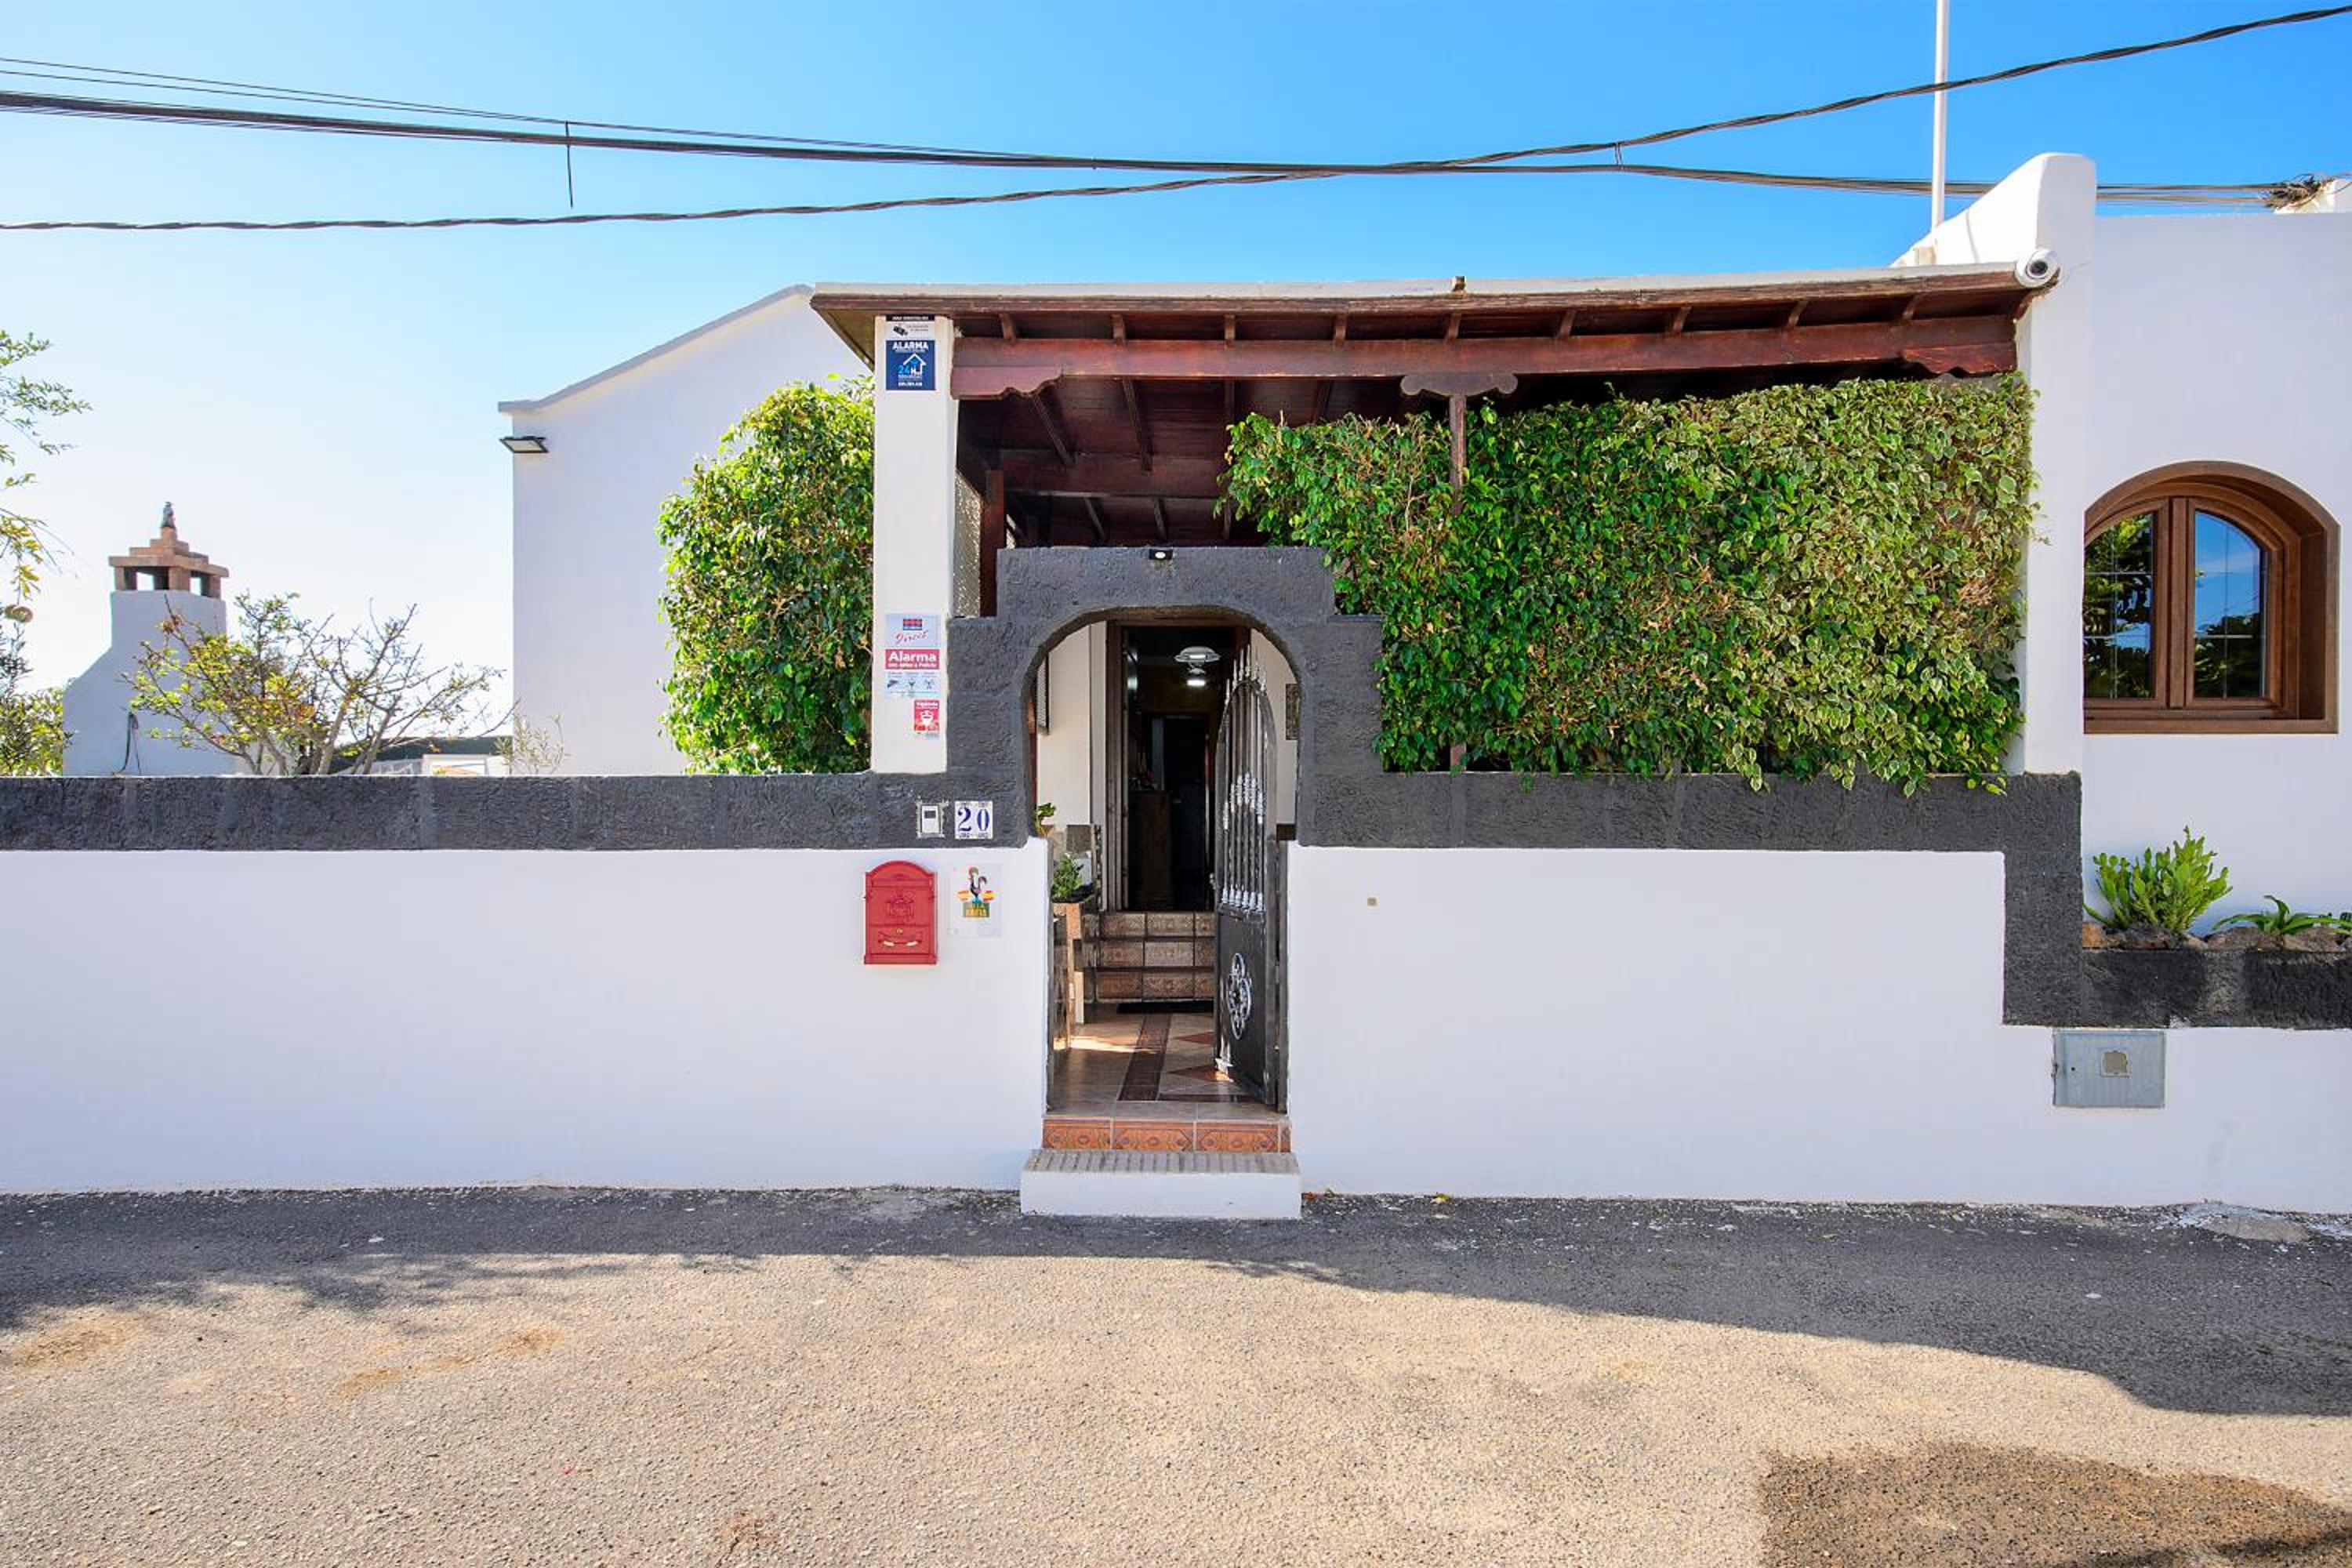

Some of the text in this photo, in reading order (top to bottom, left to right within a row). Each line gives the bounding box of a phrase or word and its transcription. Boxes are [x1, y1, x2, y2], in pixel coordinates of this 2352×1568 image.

[893, 342, 928, 350] ALARMA
[888, 651, 937, 662] Alarma
[957, 807, 990, 832] 20
